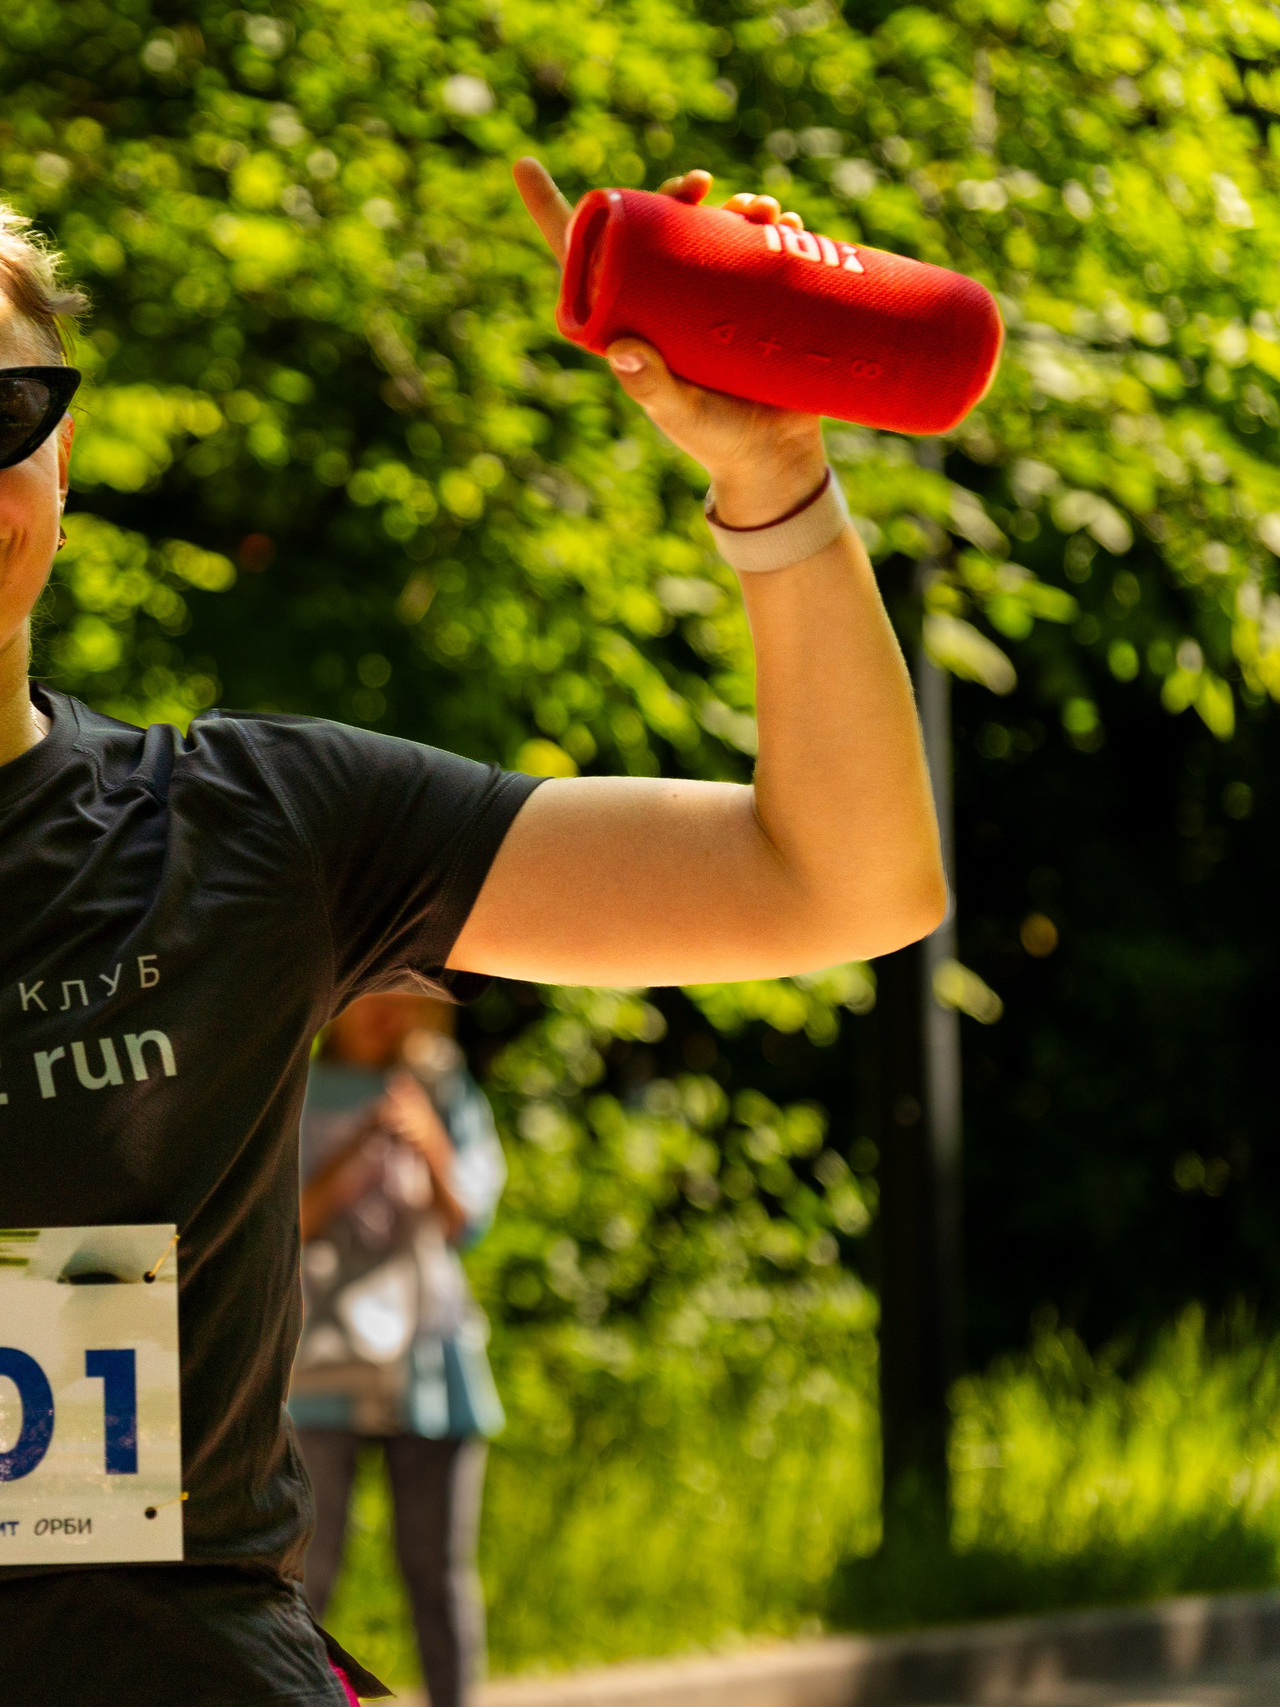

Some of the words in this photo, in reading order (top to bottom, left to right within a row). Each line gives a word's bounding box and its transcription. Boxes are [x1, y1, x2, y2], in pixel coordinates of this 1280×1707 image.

[19, 955, 161, 1011] КЛУБ
[33, 1027, 178, 1099] run
[34, 1517, 92, 1536] ОРБИ
